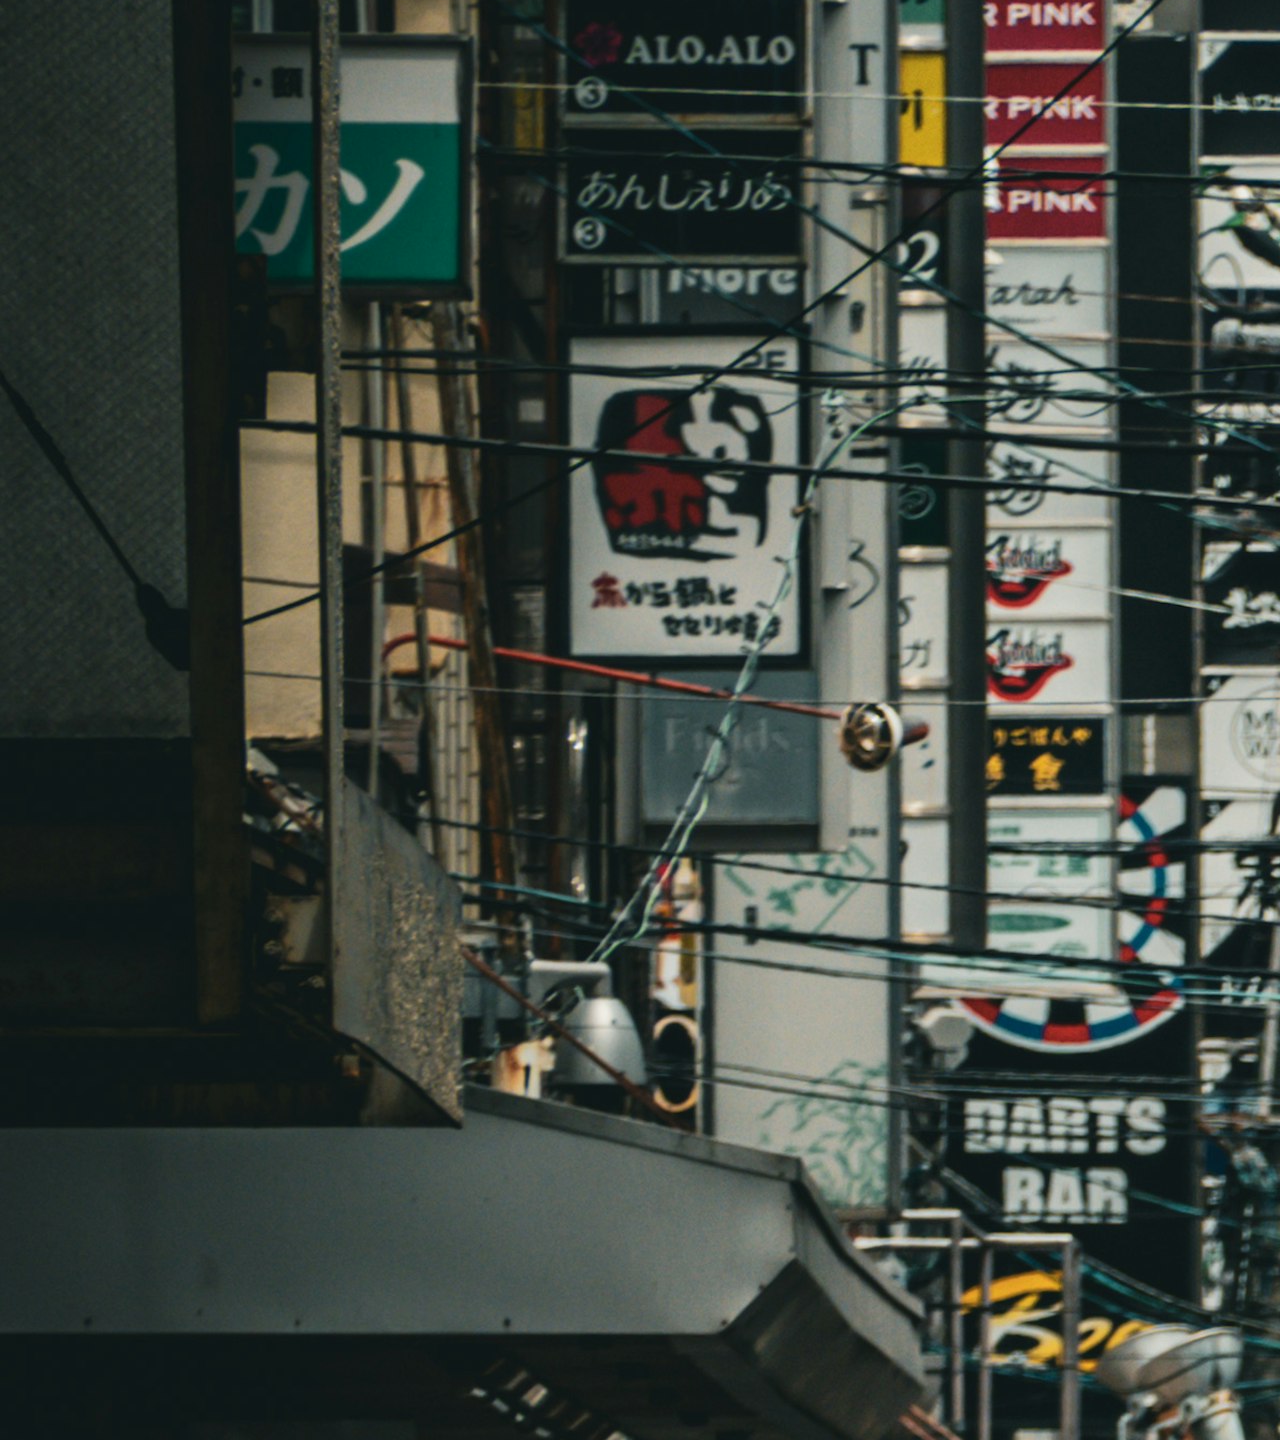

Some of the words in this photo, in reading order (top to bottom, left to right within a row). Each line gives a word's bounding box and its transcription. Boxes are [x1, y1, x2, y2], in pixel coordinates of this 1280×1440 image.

[1006, 2, 1097, 27] PINK
[625, 35, 796, 65] ALO.ALO
[1006, 95, 1098, 122] PINK
[1006, 189, 1098, 214] PINK
[963, 1097, 1168, 1156] DARTS
[1002, 1165, 1129, 1225] BAR
